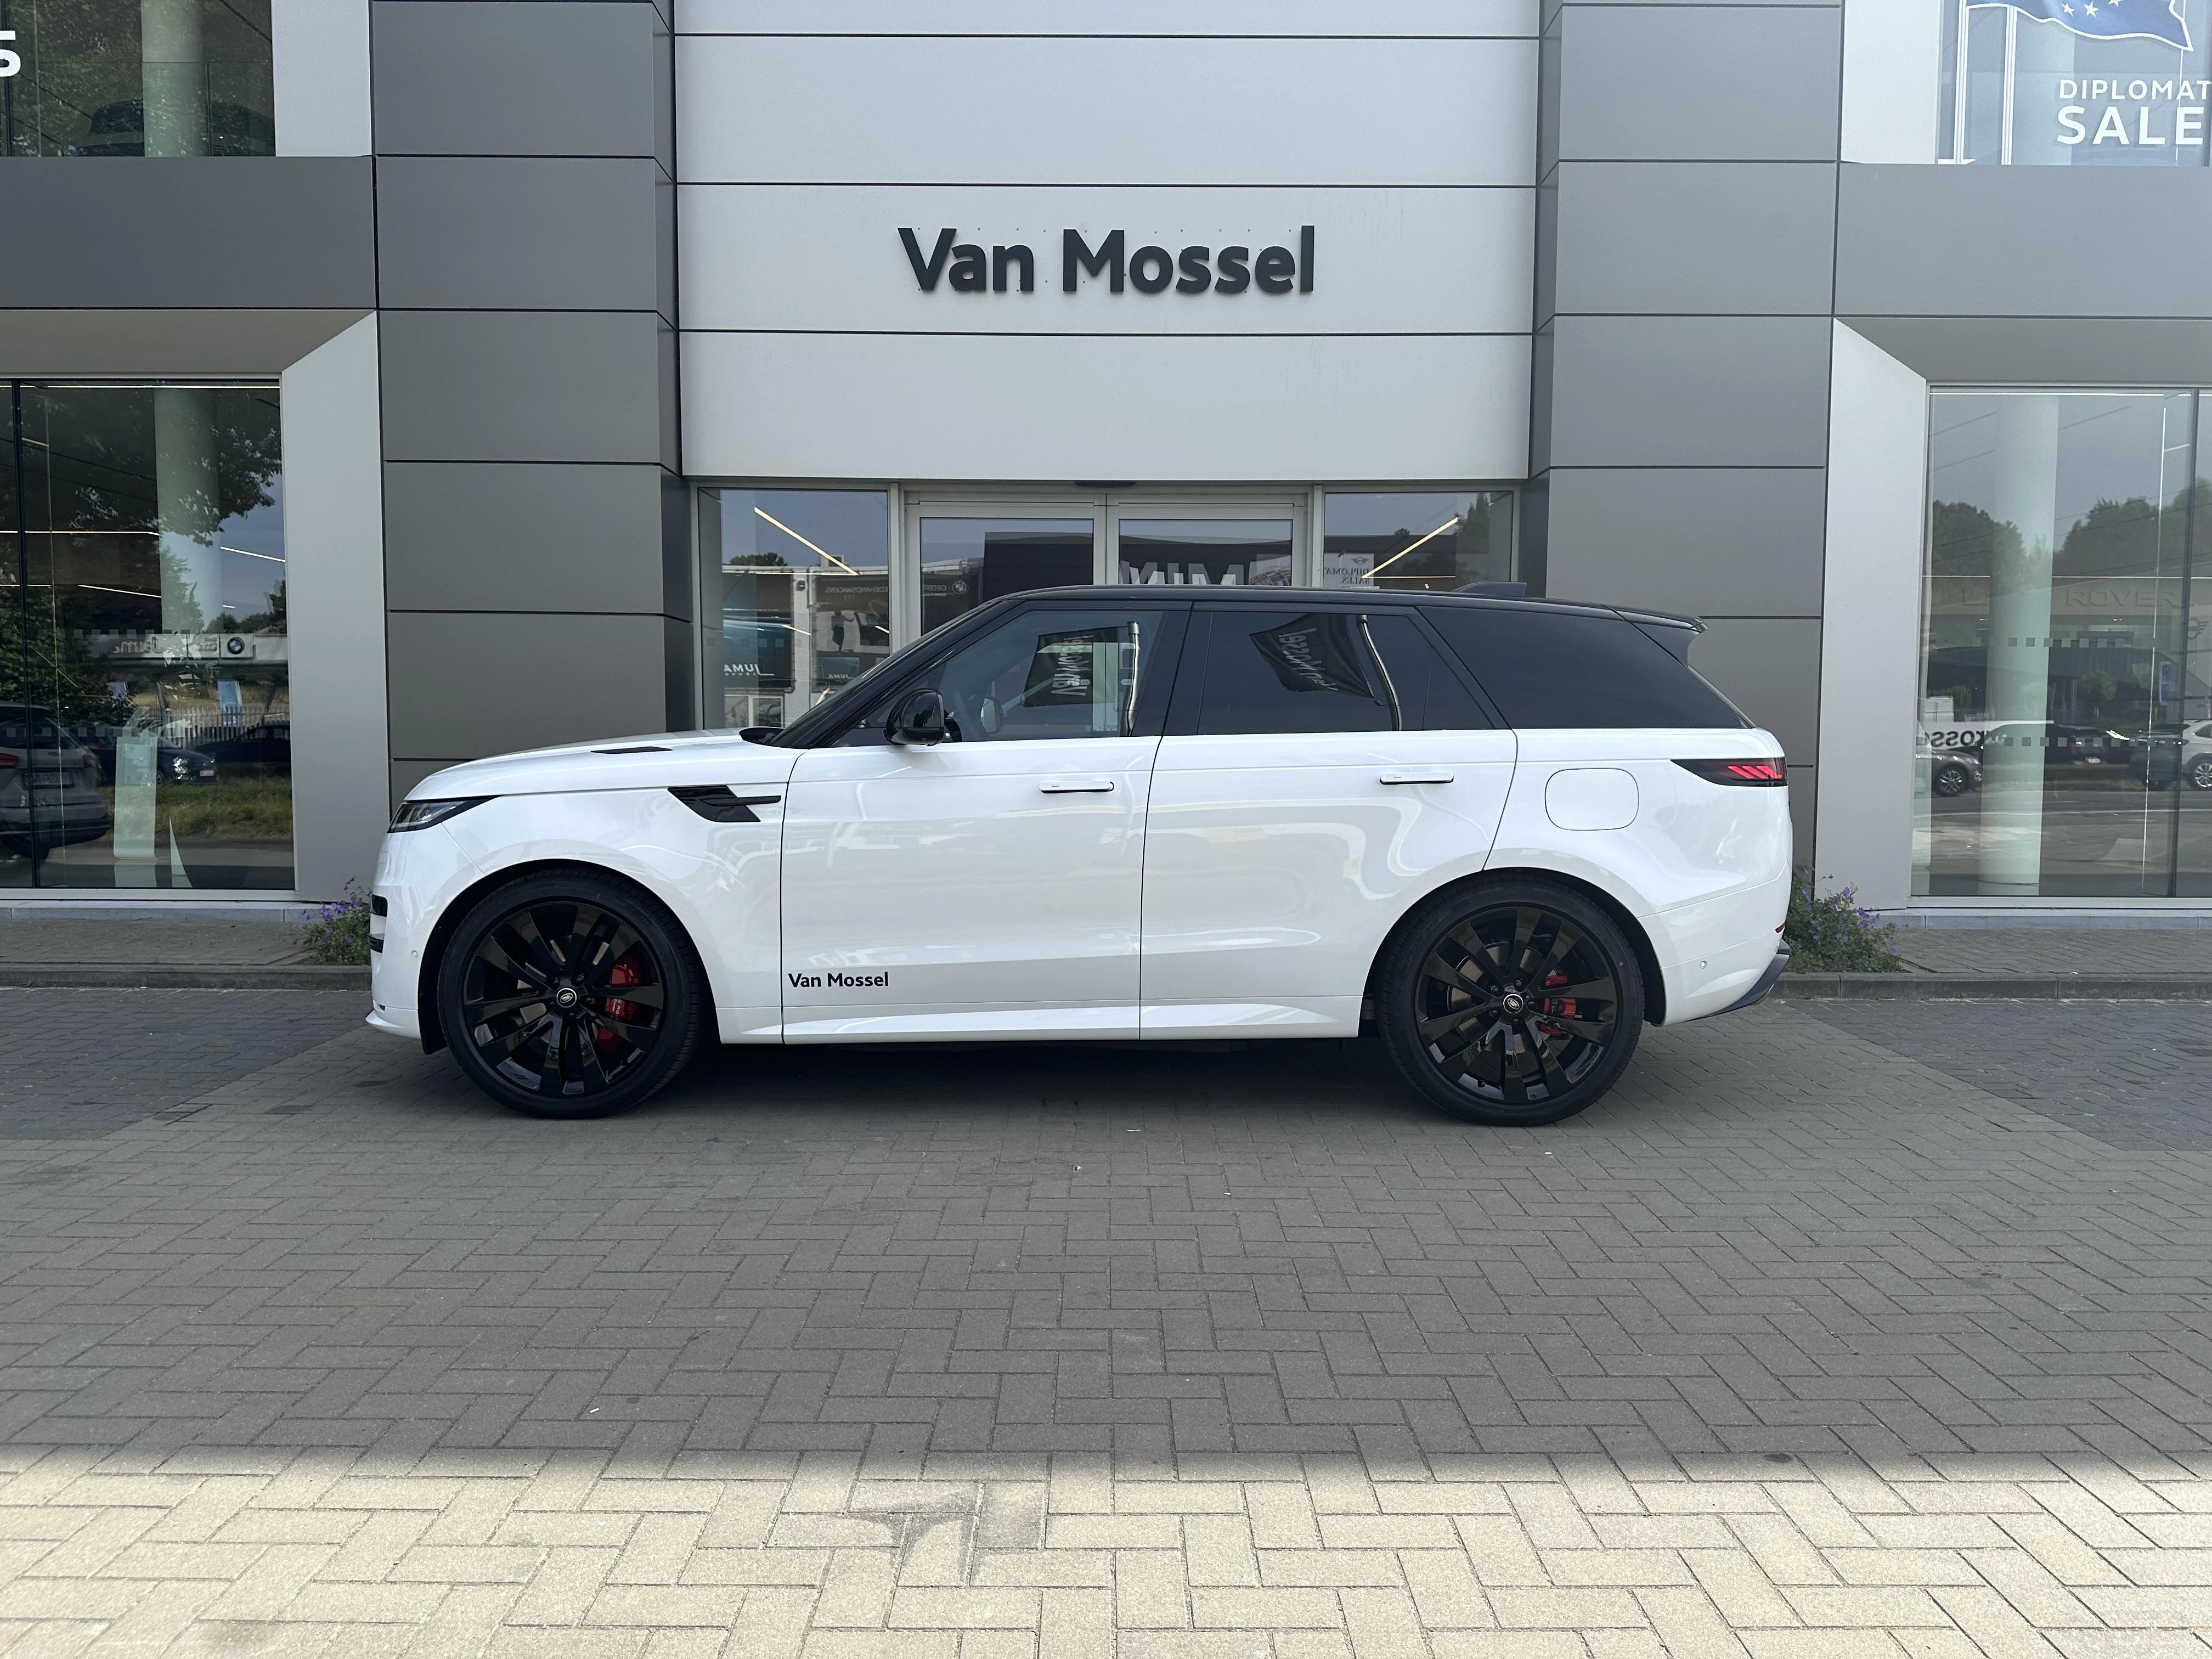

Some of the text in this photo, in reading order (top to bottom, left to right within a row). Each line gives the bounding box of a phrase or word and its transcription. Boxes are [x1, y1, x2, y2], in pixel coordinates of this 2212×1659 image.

[2059, 80, 2212, 100] DIPLOMAT
[2057, 105, 2204, 145] SALE
[898, 225, 1315, 294] Van Mossel
[2066, 589, 2185, 608] ROVER
[788, 971, 889, 988] Van Mossel
